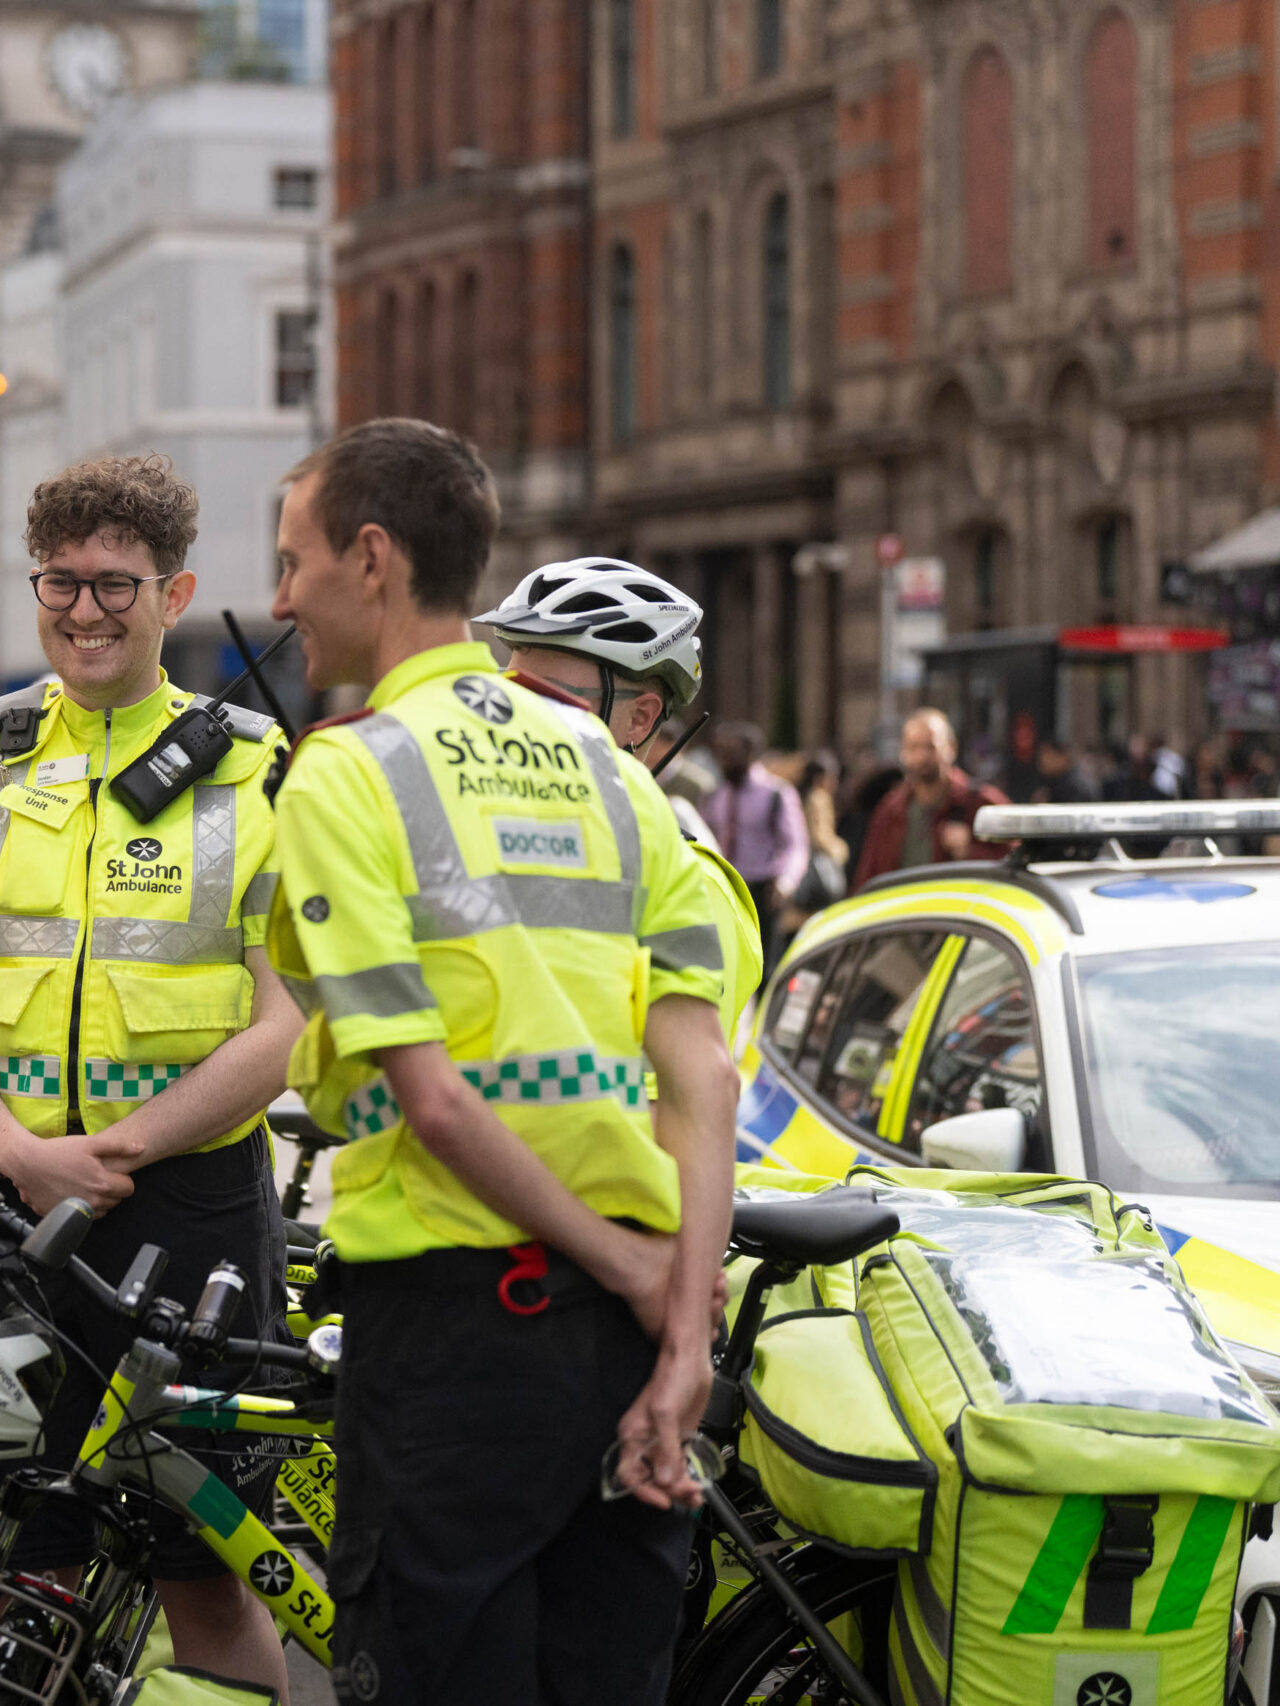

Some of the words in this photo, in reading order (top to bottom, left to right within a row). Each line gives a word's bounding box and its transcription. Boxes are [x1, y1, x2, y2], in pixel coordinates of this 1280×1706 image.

[642, 650, 653, 660] St
[653, 639, 672, 656] John
[671, 616, 698, 643] Ambulance
[435, 729, 486, 765] St
[487, 729, 580, 771] John
[459, 772, 592, 803] Ambulance
[25, 796, 48, 811] Unit
[106, 859, 127, 878] St
[130, 862, 182, 880] John
[105, 879, 182, 894] Ambulance
[288, 1590, 322, 1628] St
